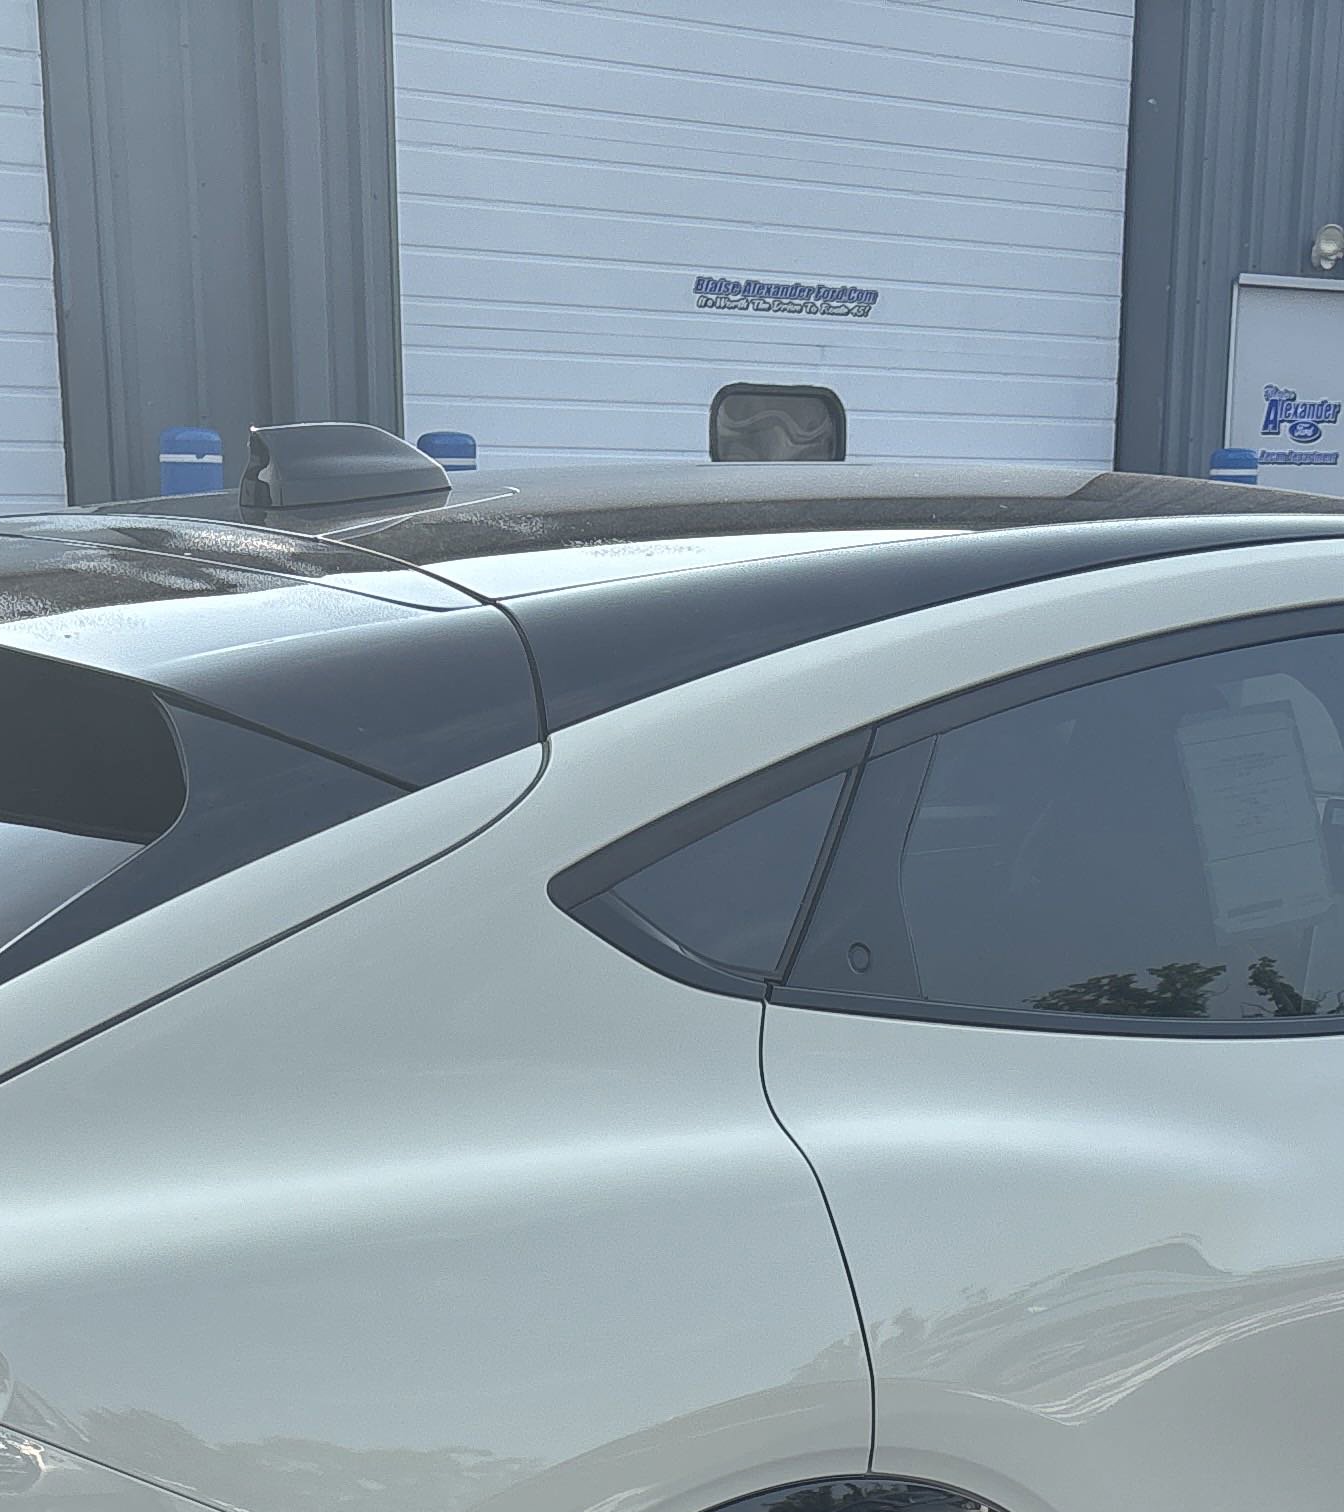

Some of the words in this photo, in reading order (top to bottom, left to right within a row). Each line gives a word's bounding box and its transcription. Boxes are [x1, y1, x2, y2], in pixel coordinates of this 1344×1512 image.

[694, 277, 742, 296] Blaise
[742, 280, 815, 301] Alexander
[1261, 398, 1340, 434] Alexander
